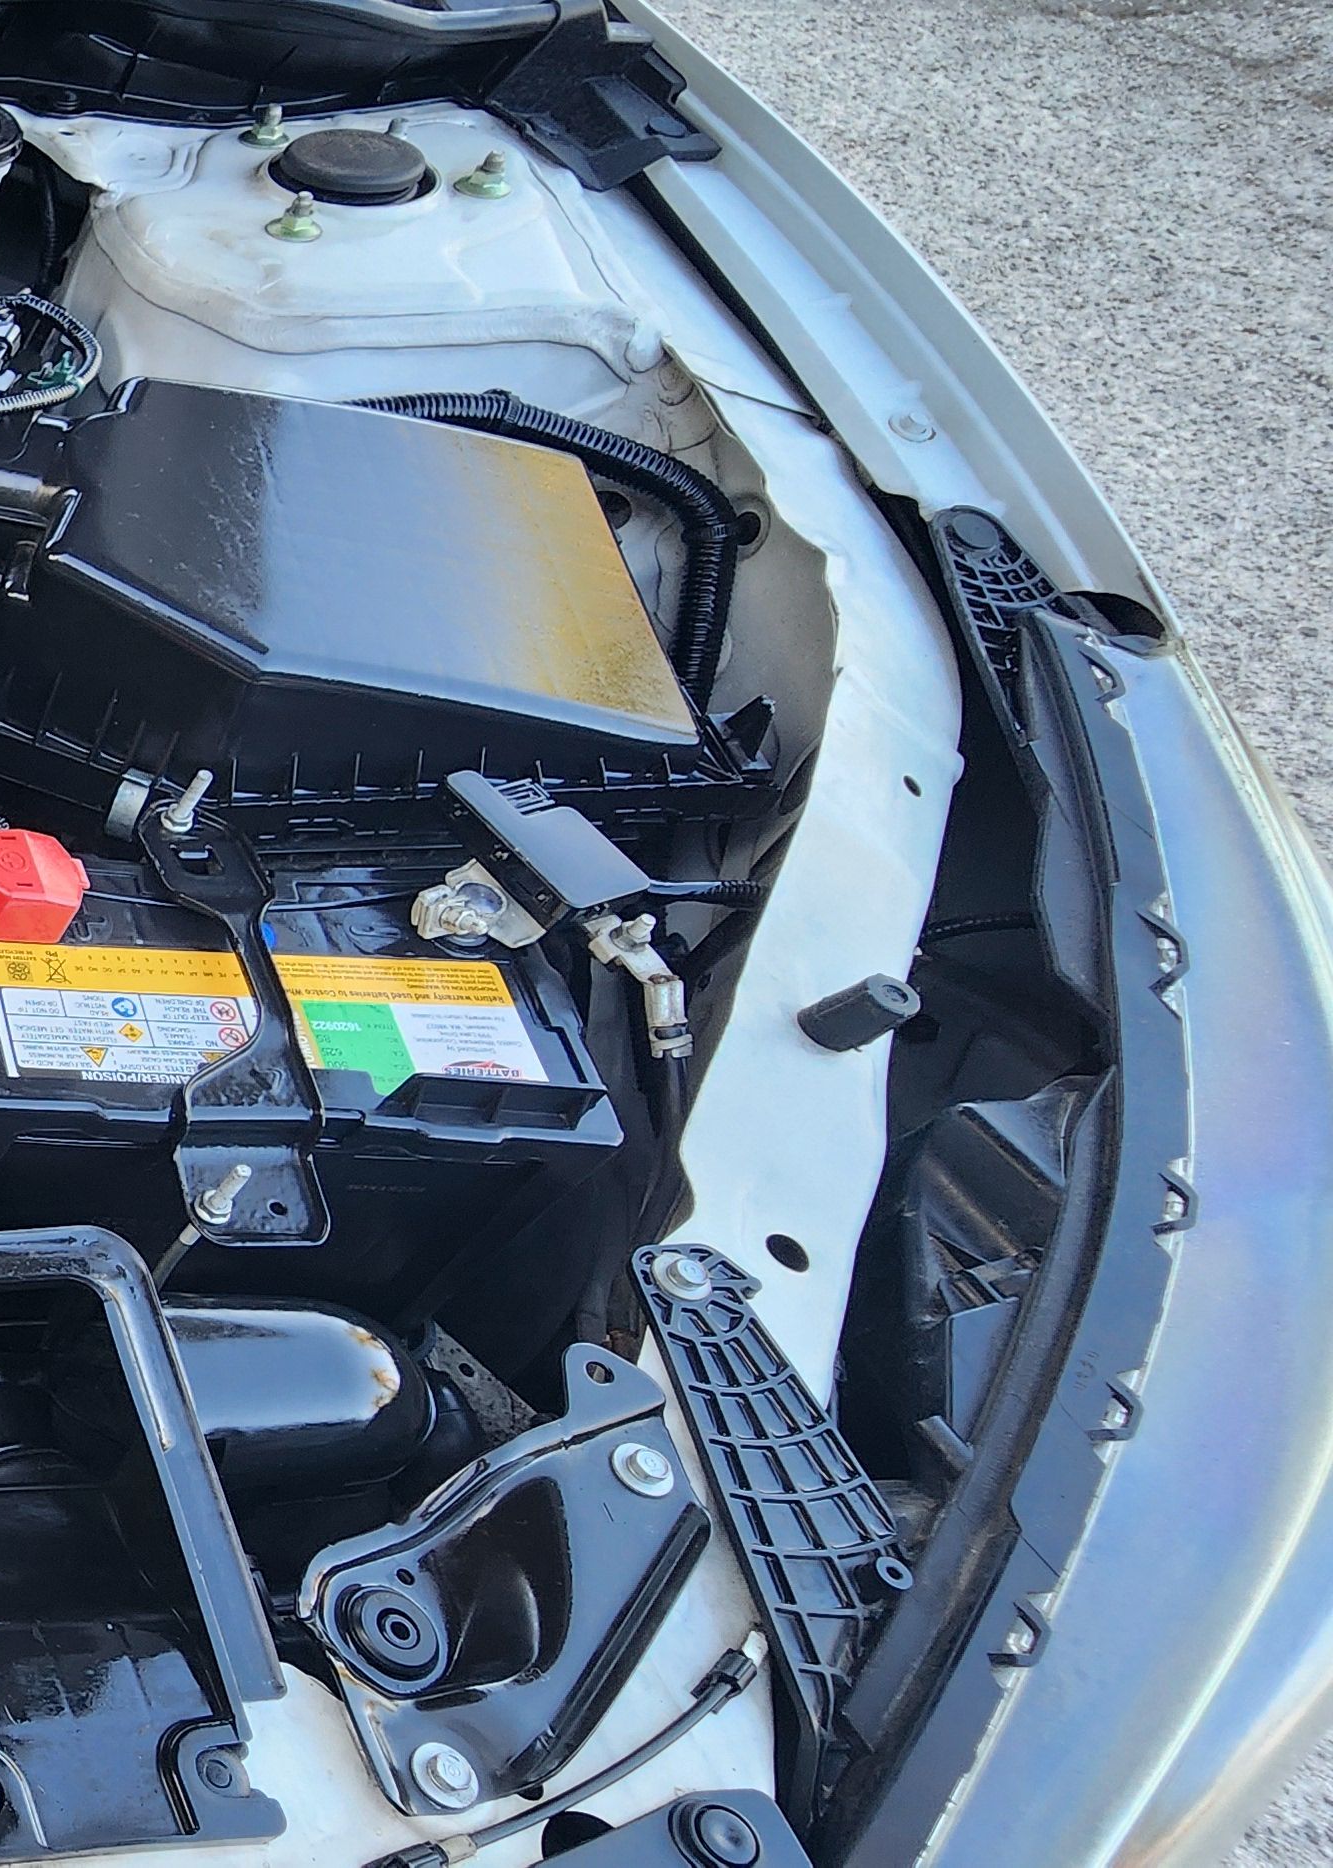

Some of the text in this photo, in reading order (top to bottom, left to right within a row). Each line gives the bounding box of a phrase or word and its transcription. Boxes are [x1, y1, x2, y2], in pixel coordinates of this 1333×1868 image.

[45, 950, 59, 959] Pb
[305, 988, 336, 998] Costco
[349, 990, 389, 1001] batteries
[391, 992, 413, 1001] used
[414, 993, 432, 1003] and
[433, 992, 471, 1002] warranty
[477, 994, 506, 1004] Return
[310, 1020, 362, 1032] 1620922
[205, 1039, 218, 1047] NO
[36, 1060, 53, 1068] ACID
[81, 1070, 191, 1085] ANGER/POISON
[443, 1067, 520, 1079] BATTERIES
